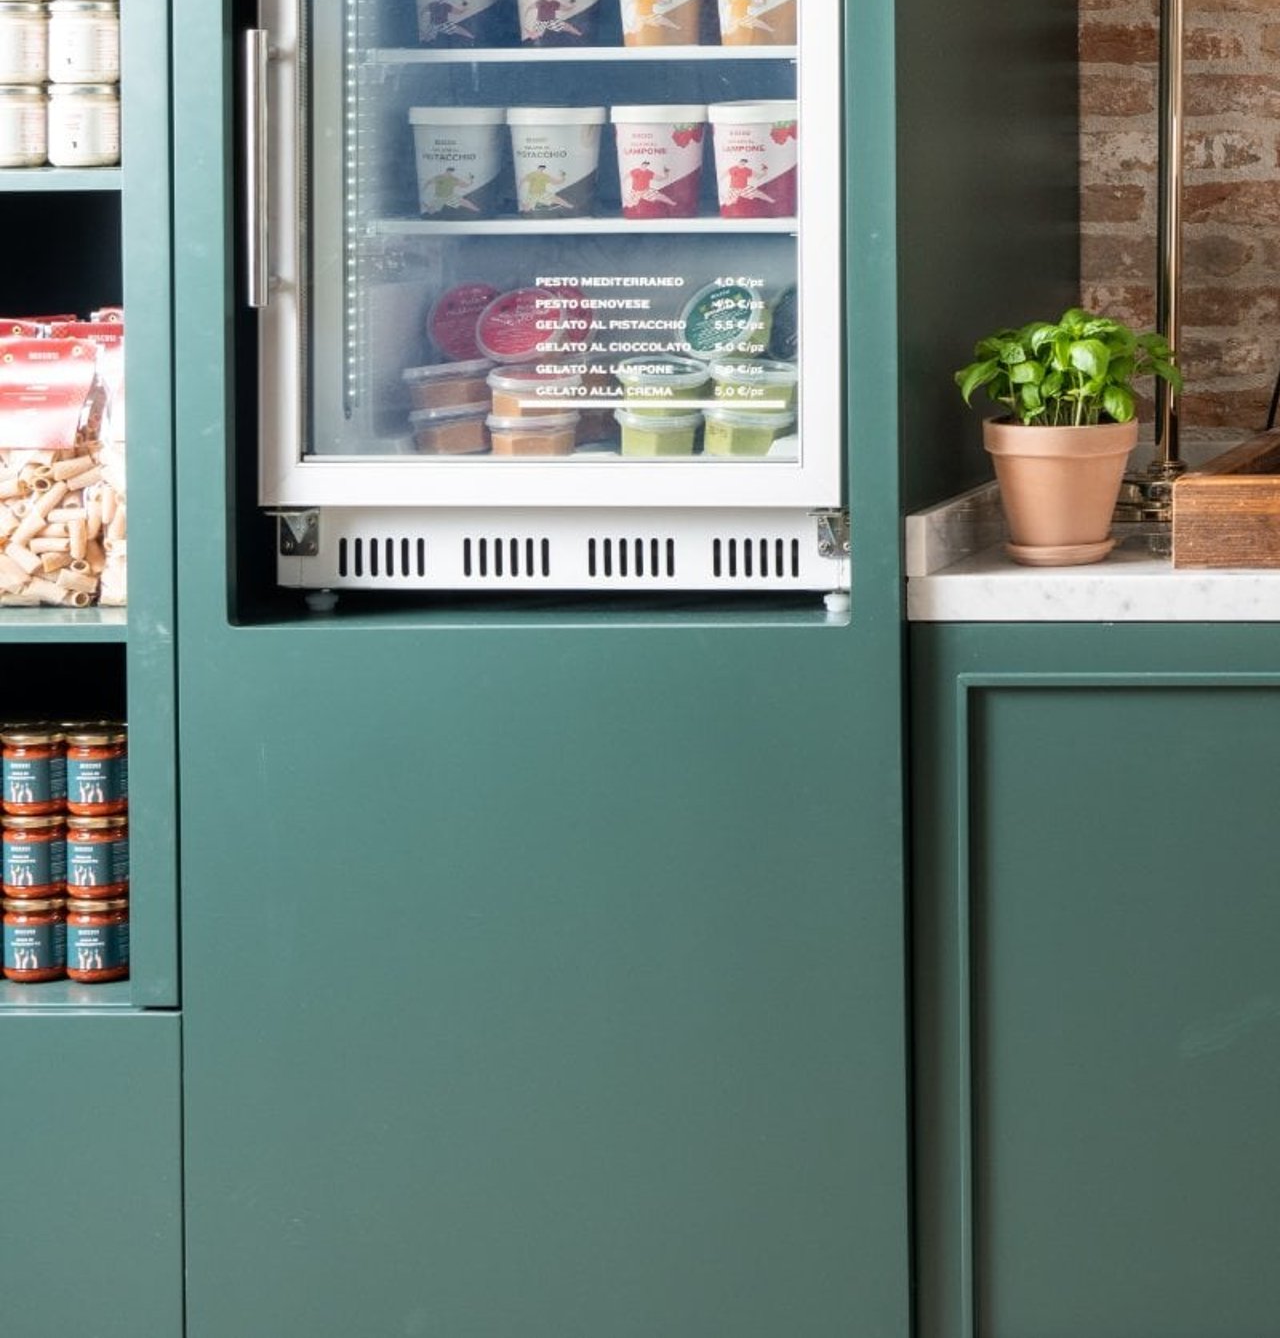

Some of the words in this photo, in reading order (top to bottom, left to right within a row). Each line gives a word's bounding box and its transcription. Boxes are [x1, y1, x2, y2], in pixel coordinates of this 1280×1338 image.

[535, 276, 578, 286] PESTO
[581, 276, 685, 286] MEDITERRANEO
[535, 299, 578, 309] PESTO
[580, 299, 650, 309] GENOVESE
[535, 320, 587, 329] GELATO
[589, 320, 606, 329] AL
[609, 320, 686, 329] PISTACCHIO
[535, 342, 587, 352] GELATO
[589, 342, 606, 352] AL
[609, 342, 692, 352] CIOCCOLATO
[535, 364, 587, 374] GELATO
[589, 364, 606, 374] AL
[609, 364, 674, 374] LAMPONE
[535, 386, 587, 396] GELATO
[589, 386, 623, 396] ALLA
[626, 386, 673, 396] CREMA
